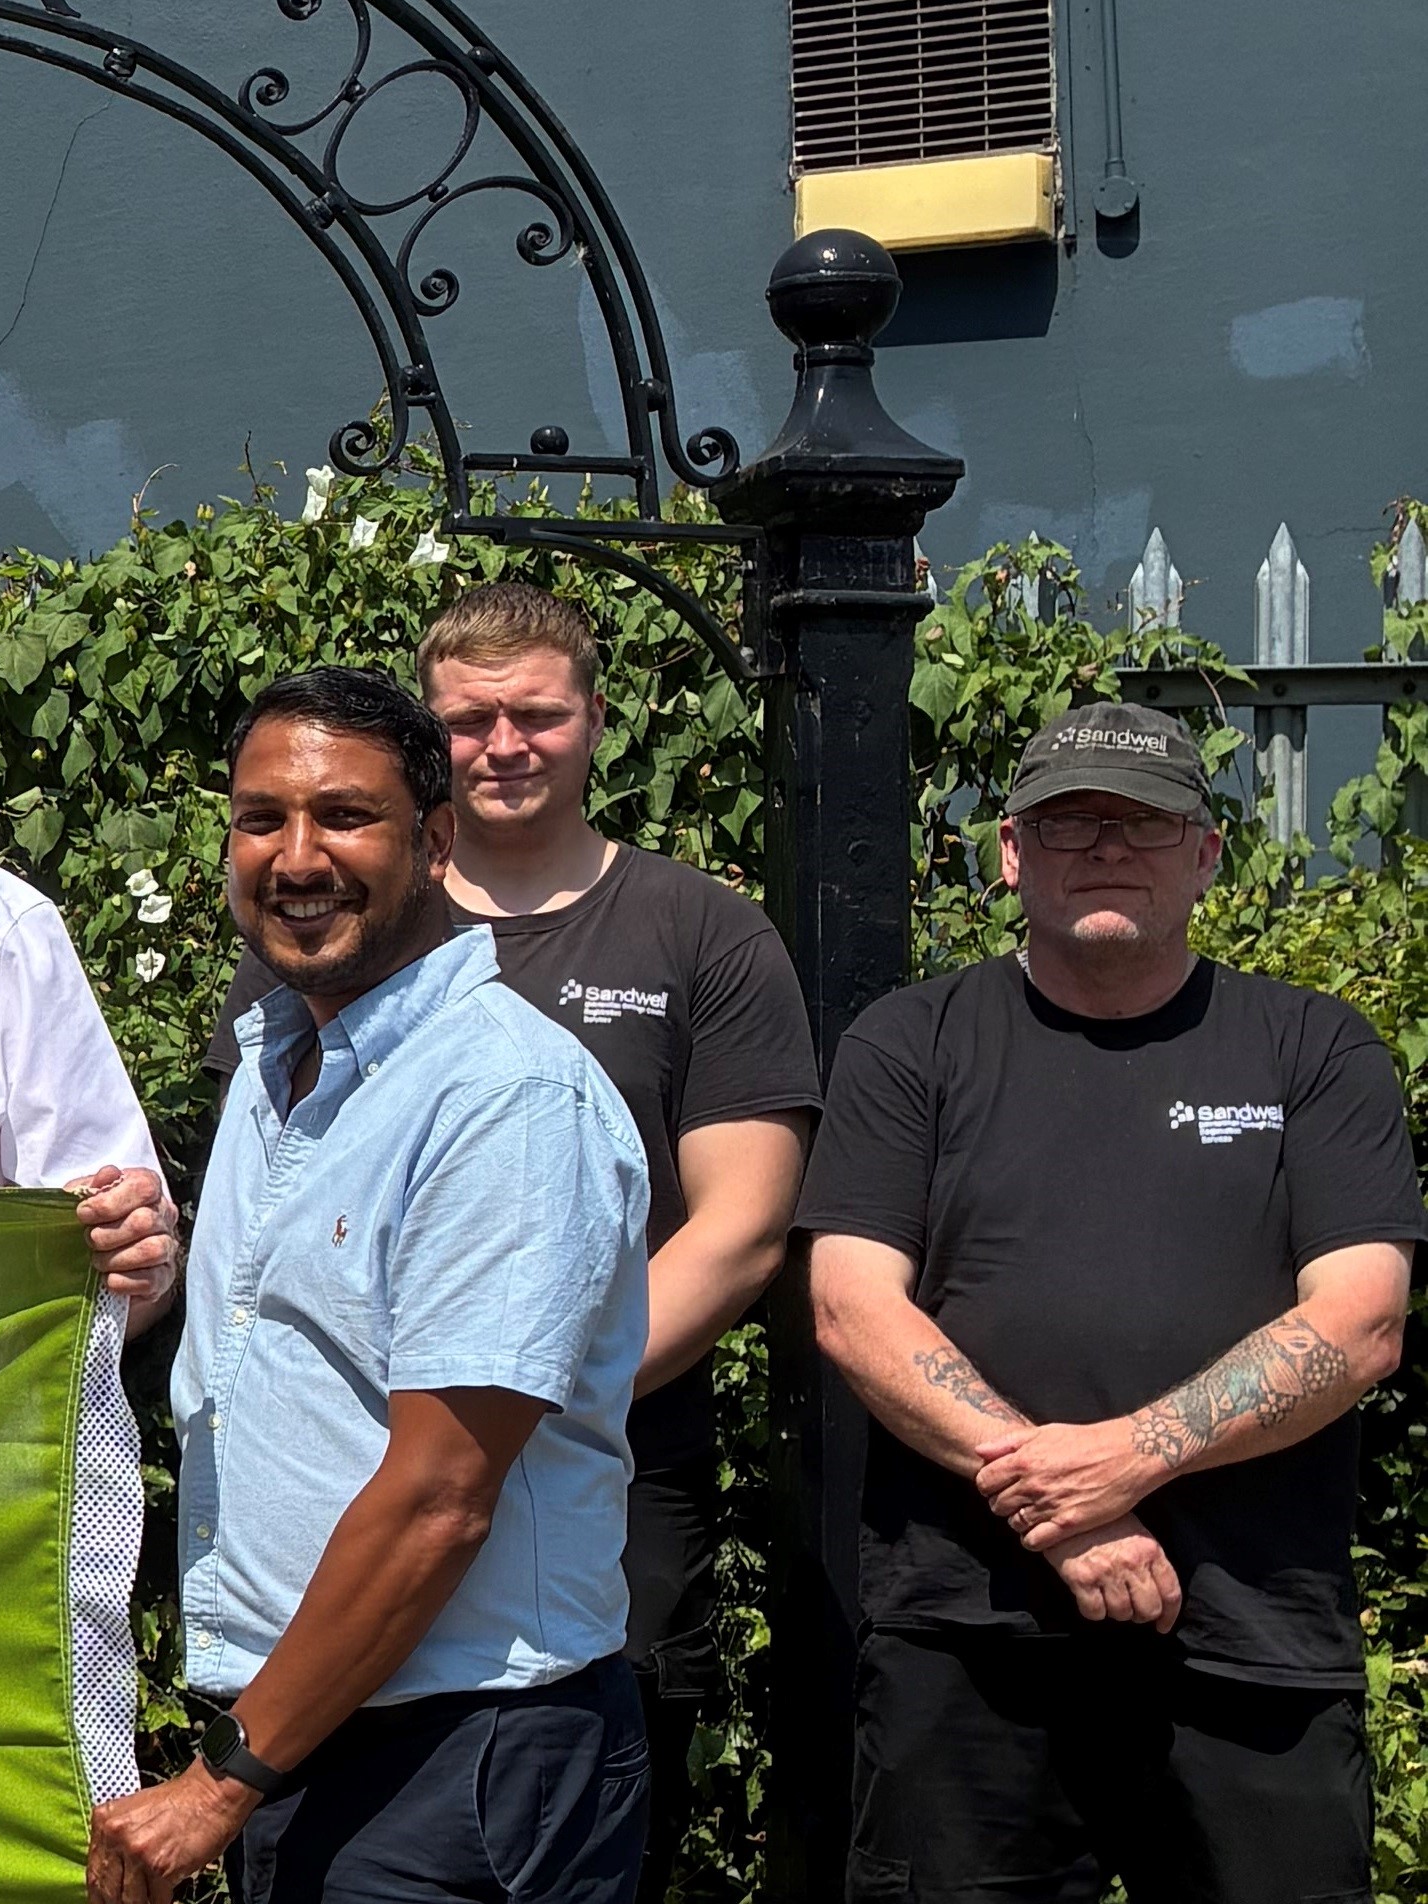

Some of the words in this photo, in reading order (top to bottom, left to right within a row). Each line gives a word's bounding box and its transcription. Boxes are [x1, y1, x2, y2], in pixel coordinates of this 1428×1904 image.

[1076, 727, 1168, 752] Sandwell
[585, 986, 669, 1009] Sandwell
[1197, 1102, 1284, 1122] Sandwel
